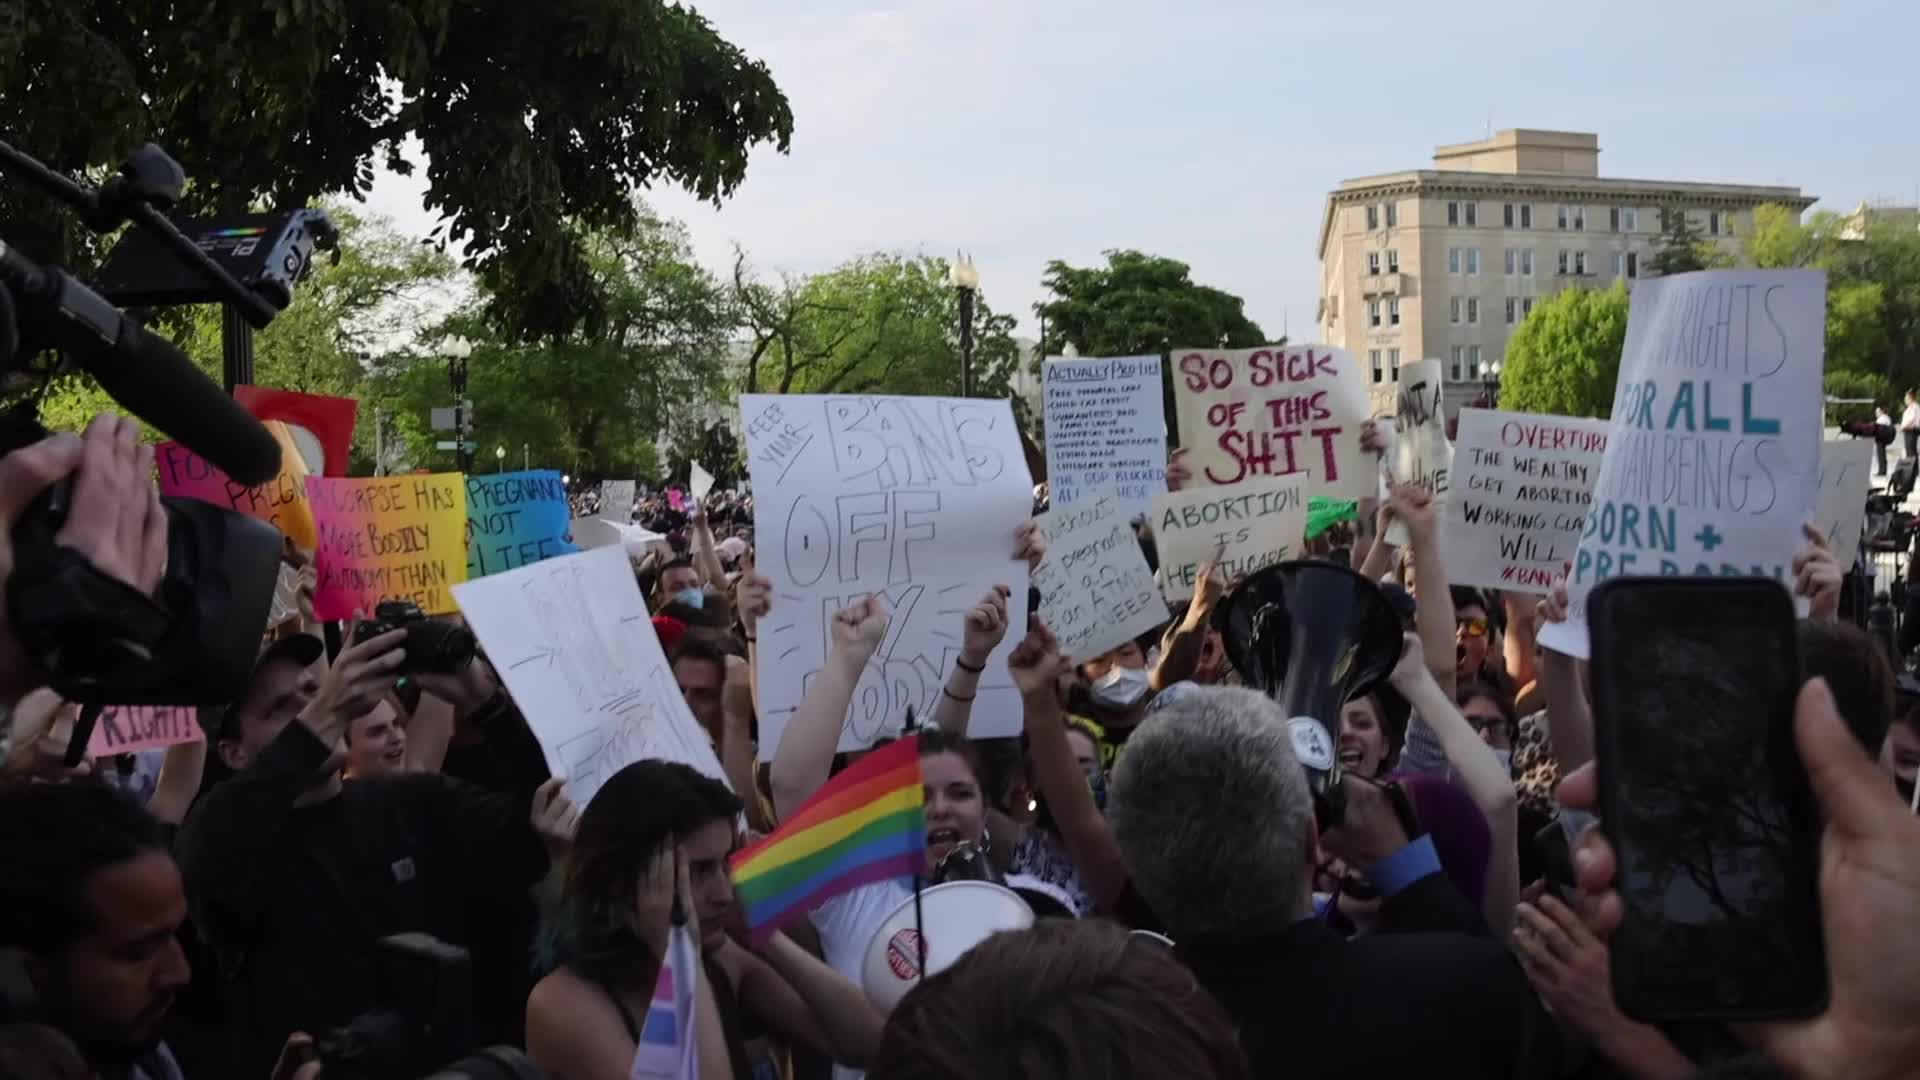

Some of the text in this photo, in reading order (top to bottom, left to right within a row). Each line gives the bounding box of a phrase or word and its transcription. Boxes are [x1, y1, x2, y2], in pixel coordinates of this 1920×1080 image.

[1179, 350, 1338, 393] SO SICK
[1207, 391, 1331, 427] OF THIS
[1615, 380, 1781, 434] FOR ALL
[824, 398, 1004, 489] BANS
[1205, 427, 1342, 485] SHIT
[166, 447, 216, 486] FO
[1469, 474, 1503, 494] GET
[1470, 448, 1588, 484] THE WEALTHY
[332, 483, 406, 513] CORPSE
[413, 479, 456, 511] HAS
[1162, 486, 1301, 532] ABORTION
[470, 510, 520, 536] NOT
[1463, 500, 1547, 530] WORKING
[1583, 500, 1676, 552] BORN
[367, 522, 430, 557] BODILY
[785, 491, 941, 586] OFF
[1213, 527, 1250, 546] IS
[1501, 533, 1566, 562] WILL
[393, 560, 446, 588] THAN
[1166, 546, 1289, 588] HETHCARE
[803, 647, 963, 743] ODY
